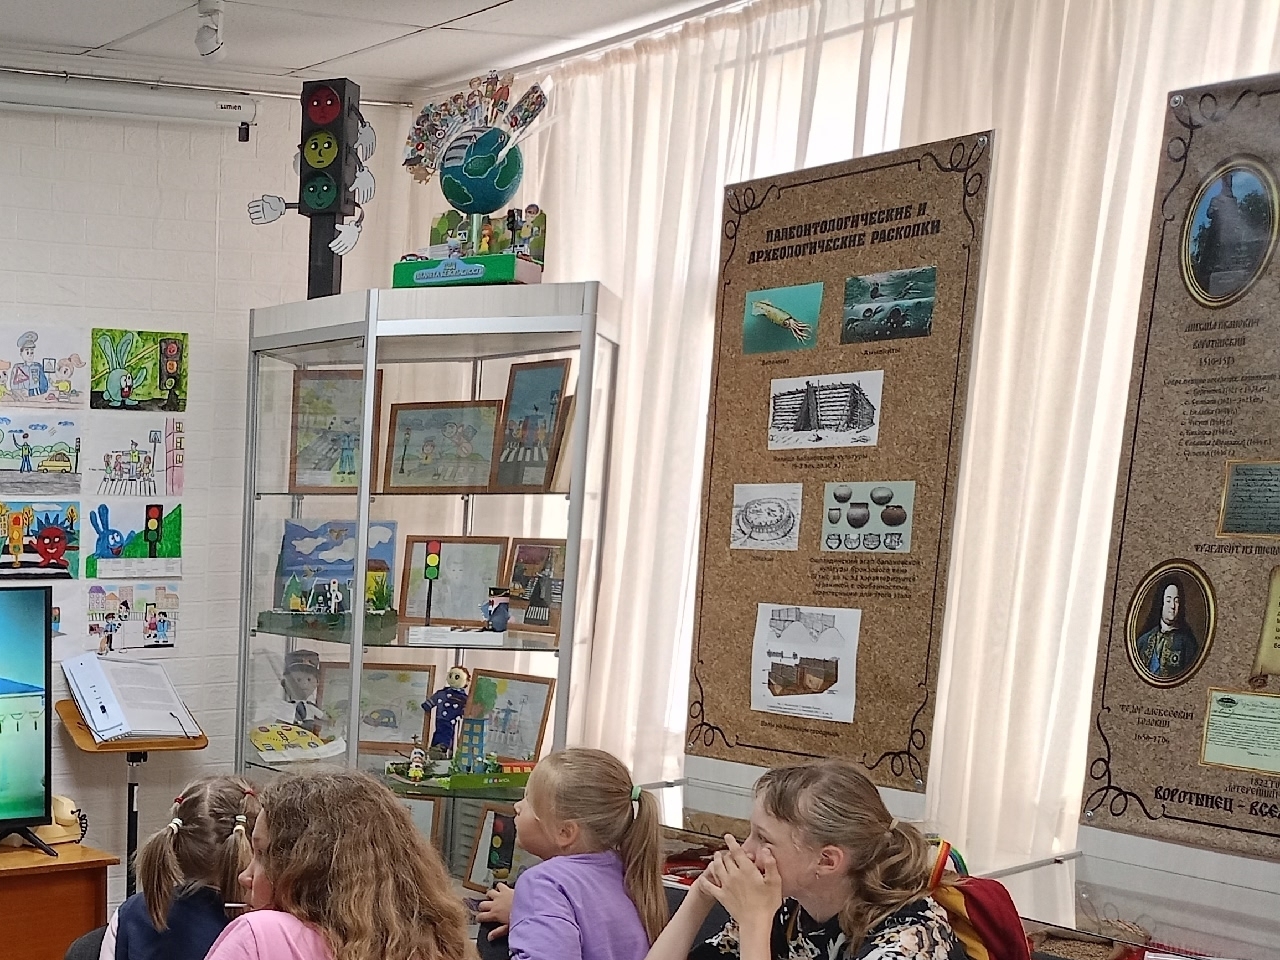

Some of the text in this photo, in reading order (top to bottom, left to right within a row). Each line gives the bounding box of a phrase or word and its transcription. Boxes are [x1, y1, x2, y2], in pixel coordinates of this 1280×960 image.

[747, 220, 941, 264] АРХЕОЛОГИЧЕСКИЕ РАСКОПКИ
[766, 202, 928, 243] ПАЛЕОНТОЛОГИЧЕСКИЕ И
[1154, 785, 1234, 814] ВОРОТЫНЕЦ
